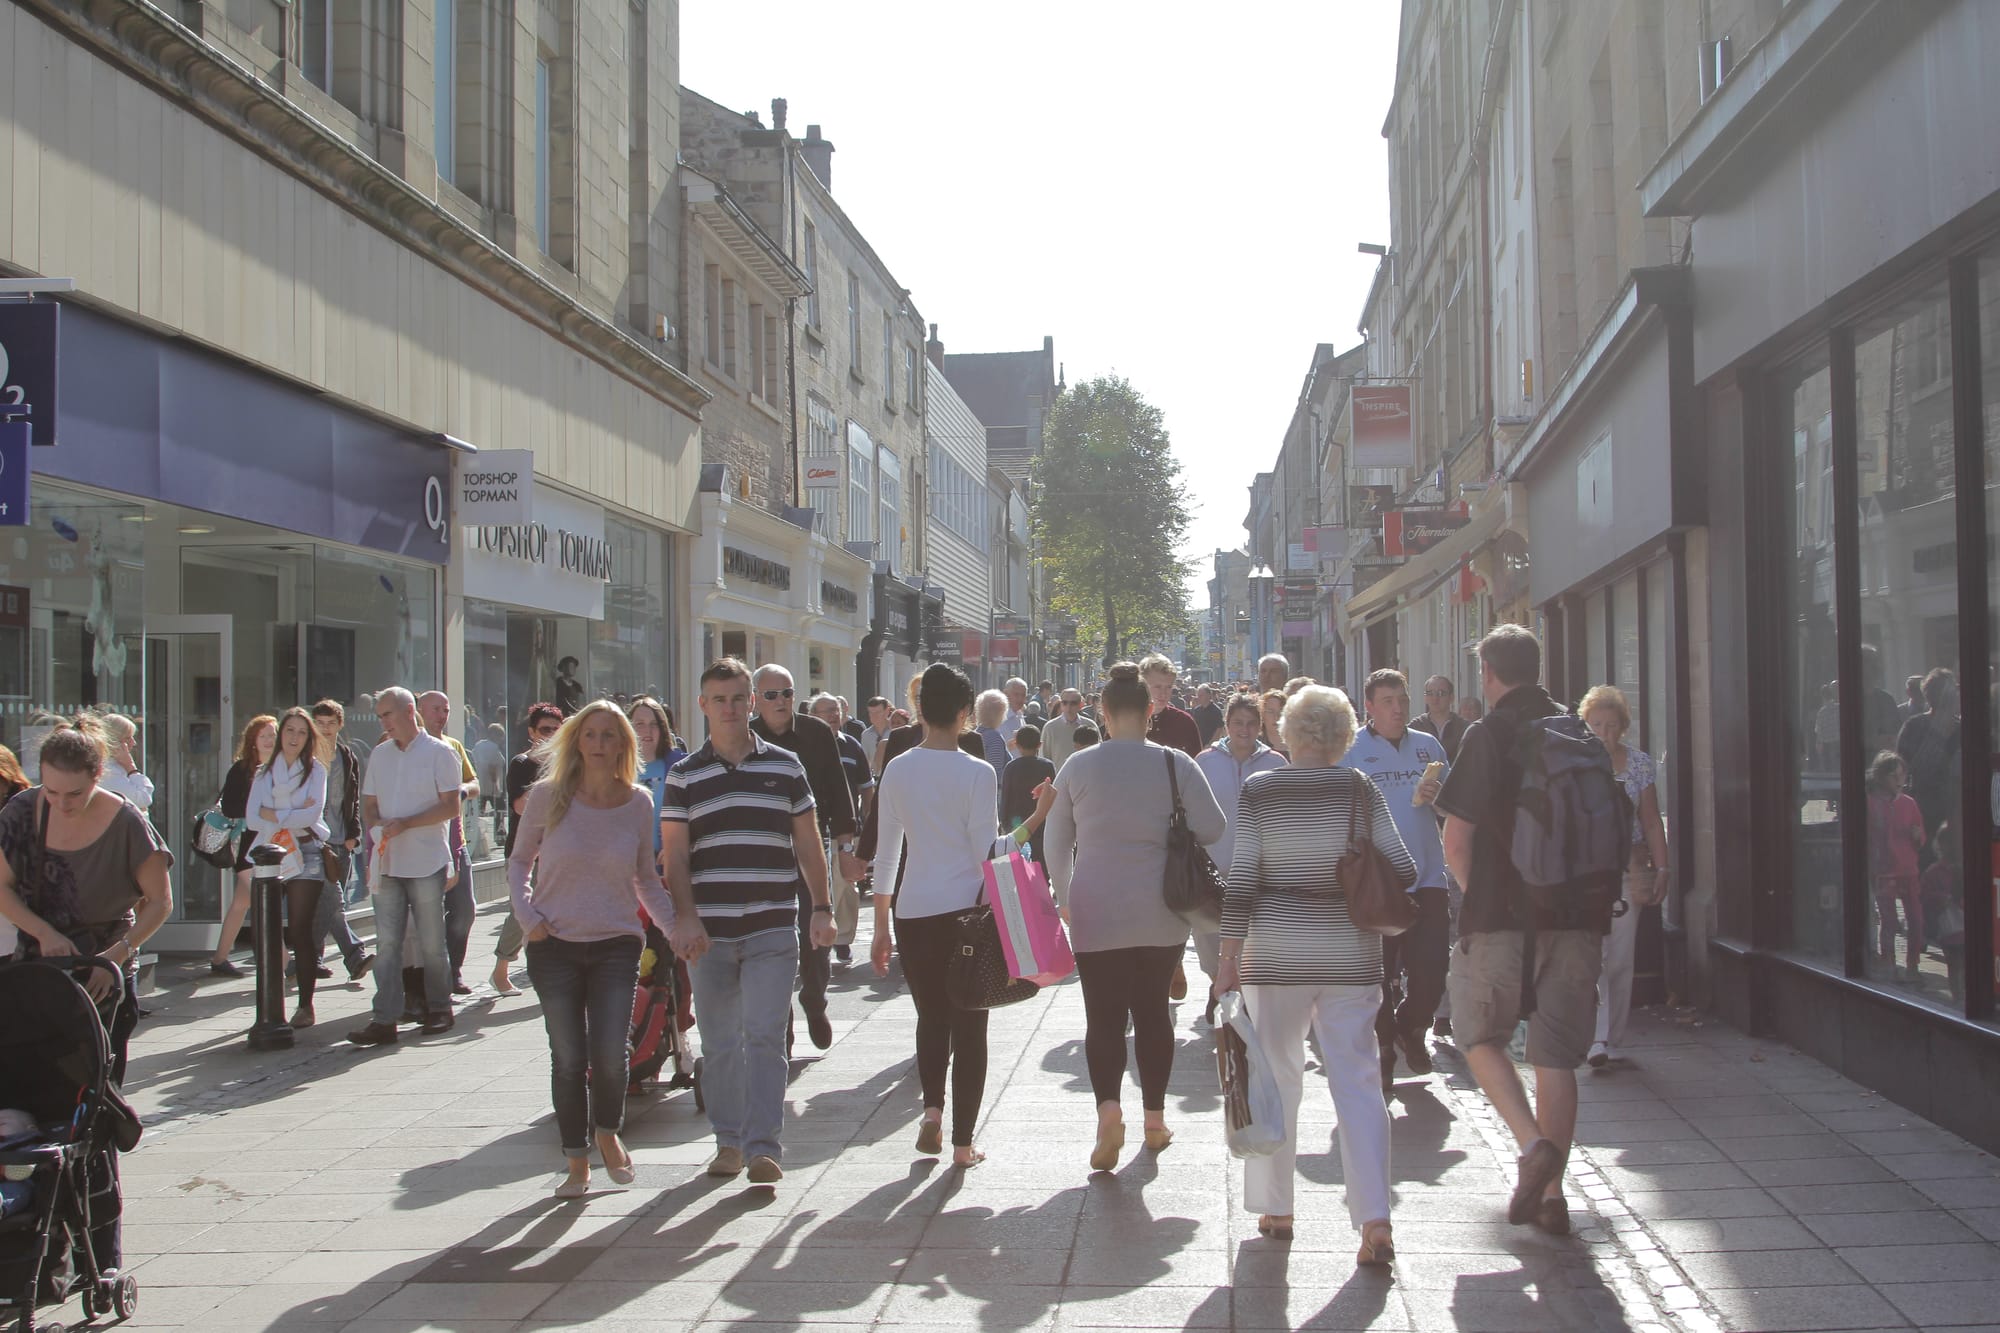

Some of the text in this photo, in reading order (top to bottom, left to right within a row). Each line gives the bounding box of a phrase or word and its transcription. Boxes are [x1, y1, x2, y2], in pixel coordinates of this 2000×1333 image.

[1361, 402, 1401, 411] INSPIRE
[463, 472, 518, 486] TOPSHOP
[463, 489, 518, 503] TOPMAN
[425, 475, 447, 544] O2
[1407, 524, 1457, 541] Thornton
[558, 528, 613, 583] TOPMAN
[936, 640, 957, 648] vision
[1370, 768, 1426, 783] ETIHA
